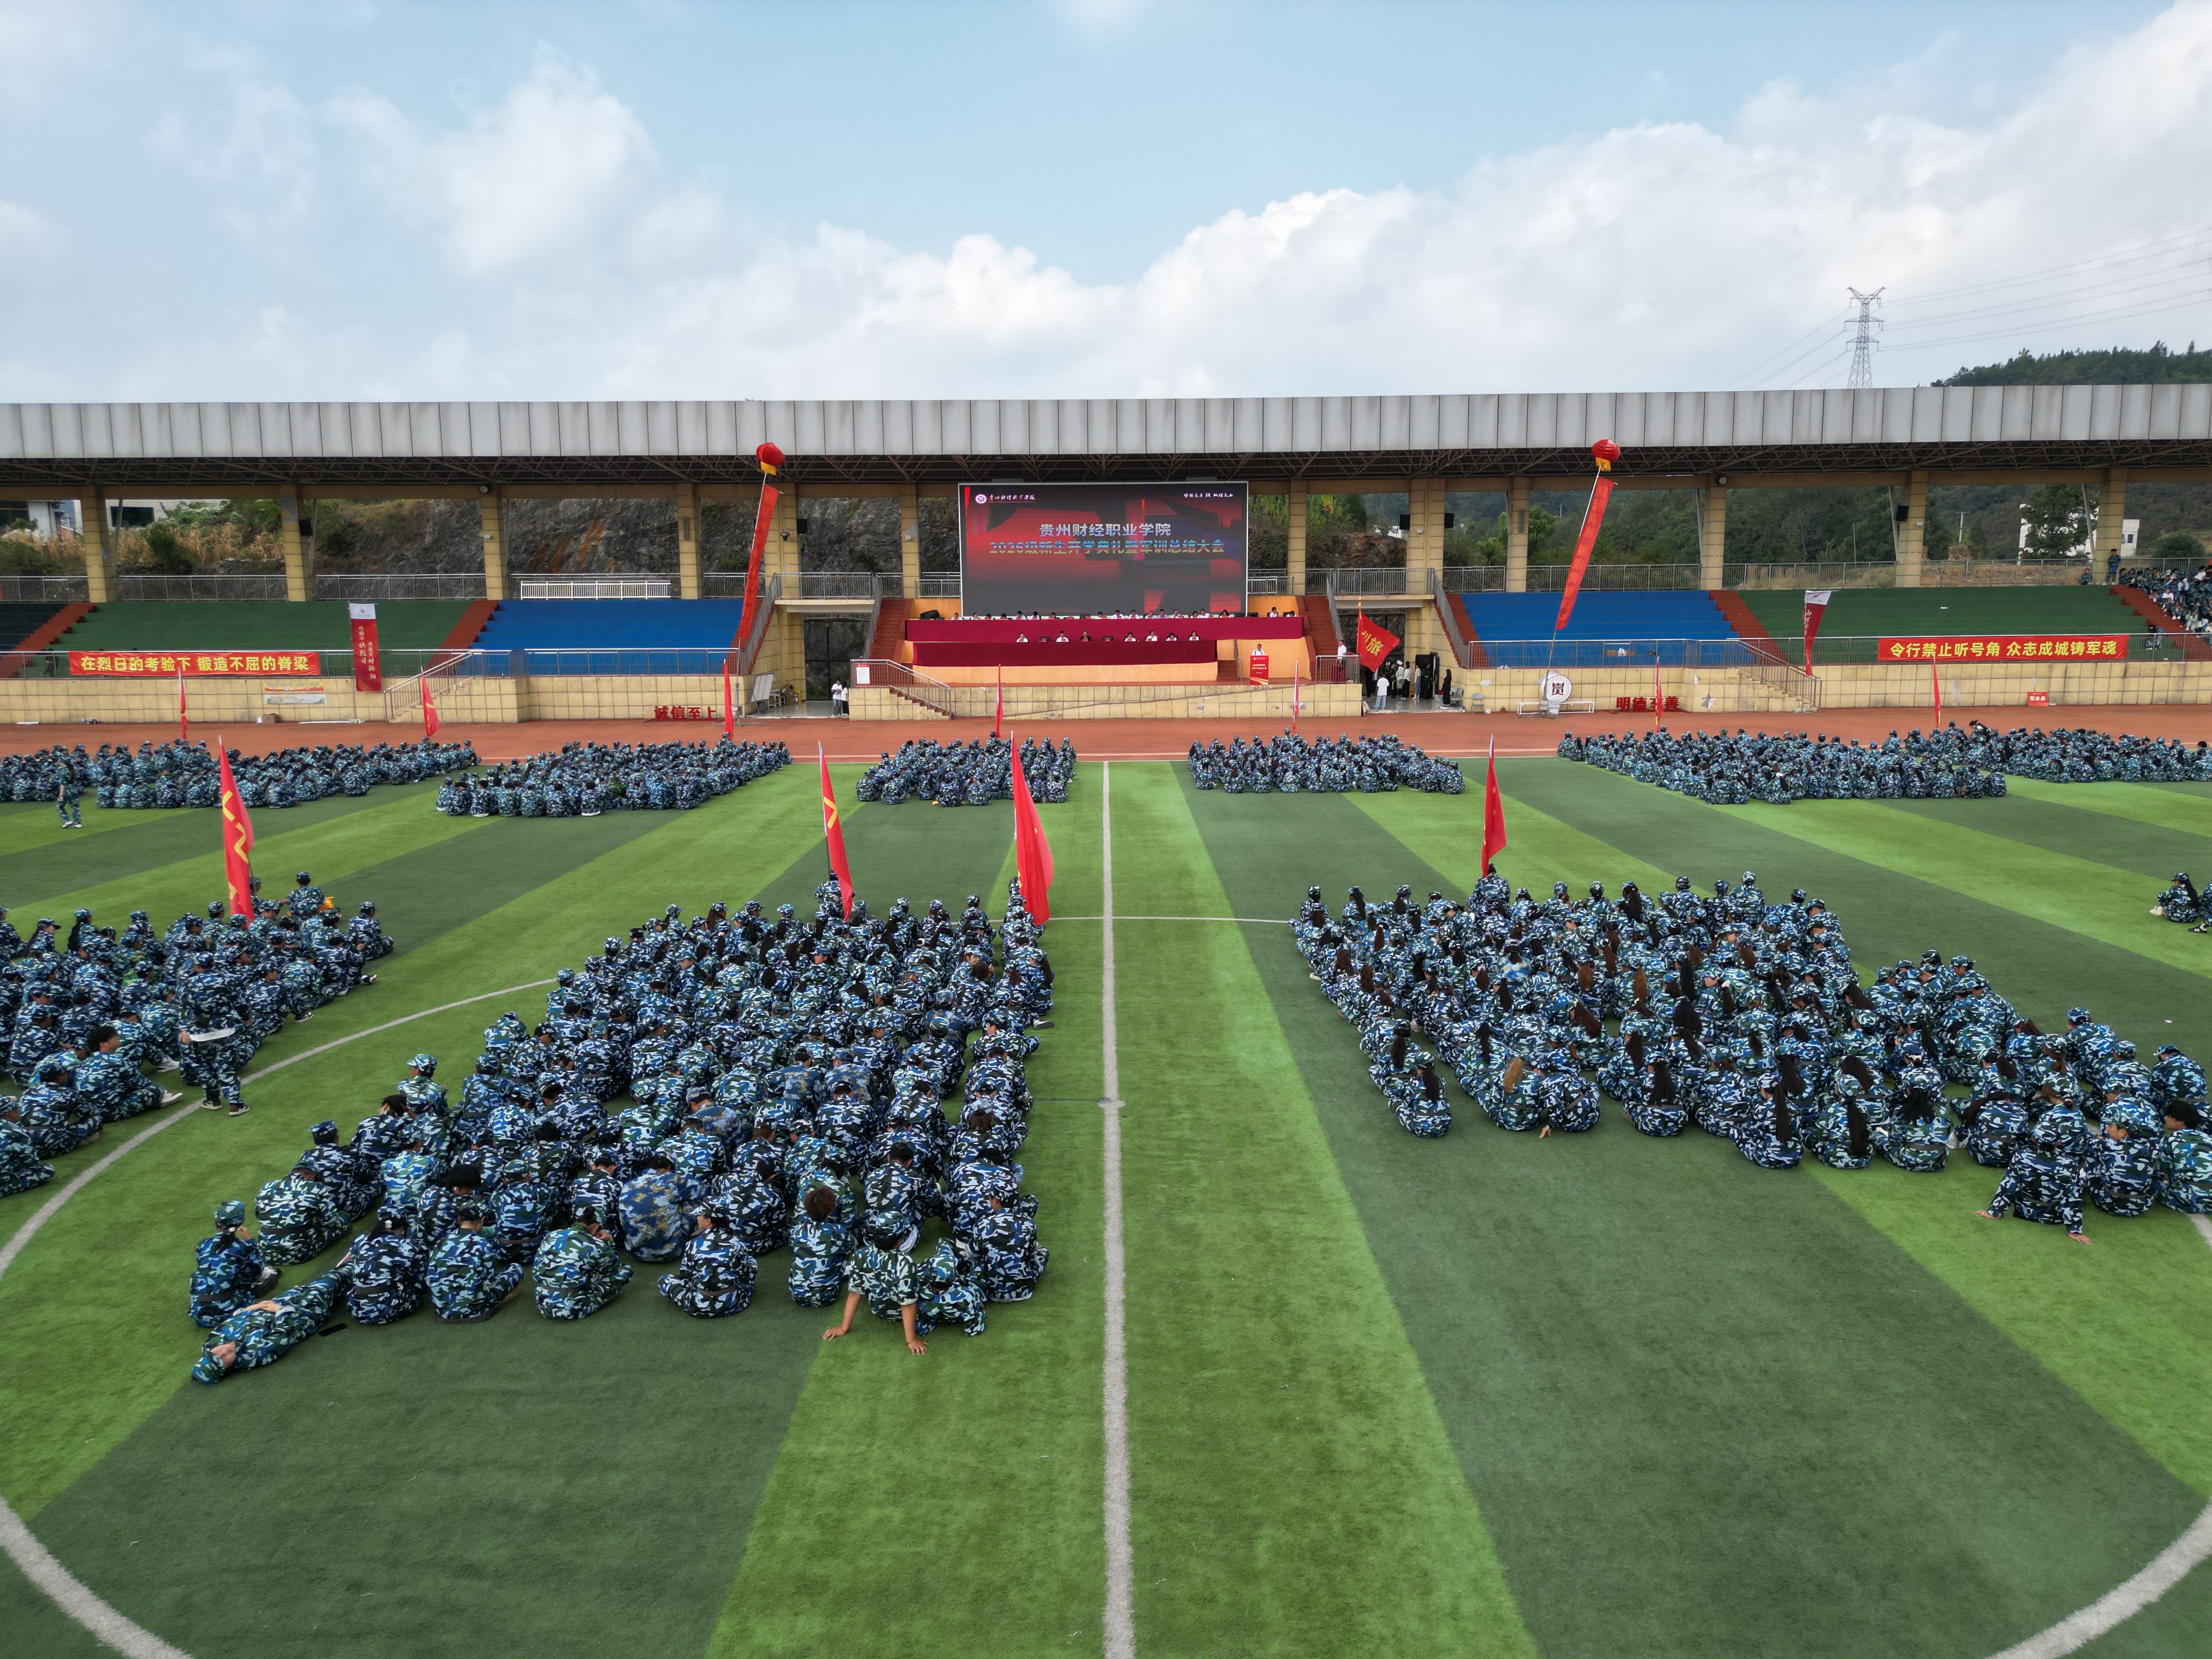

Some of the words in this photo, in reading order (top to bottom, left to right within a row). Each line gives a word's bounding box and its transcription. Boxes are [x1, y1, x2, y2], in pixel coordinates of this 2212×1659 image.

[1040, 523, 1171, 537] 贵州财经职业学院
[1891, 642, 2000, 658] 令行禁止听号角
[2006, 641, 2117, 657] 众志成城铸军魂
[81, 656, 191, 672] 在烈日的考验下
[197, 656, 309, 672] 锻造不屈的脊梁
[653, 706, 716, 720] 诚信至上
